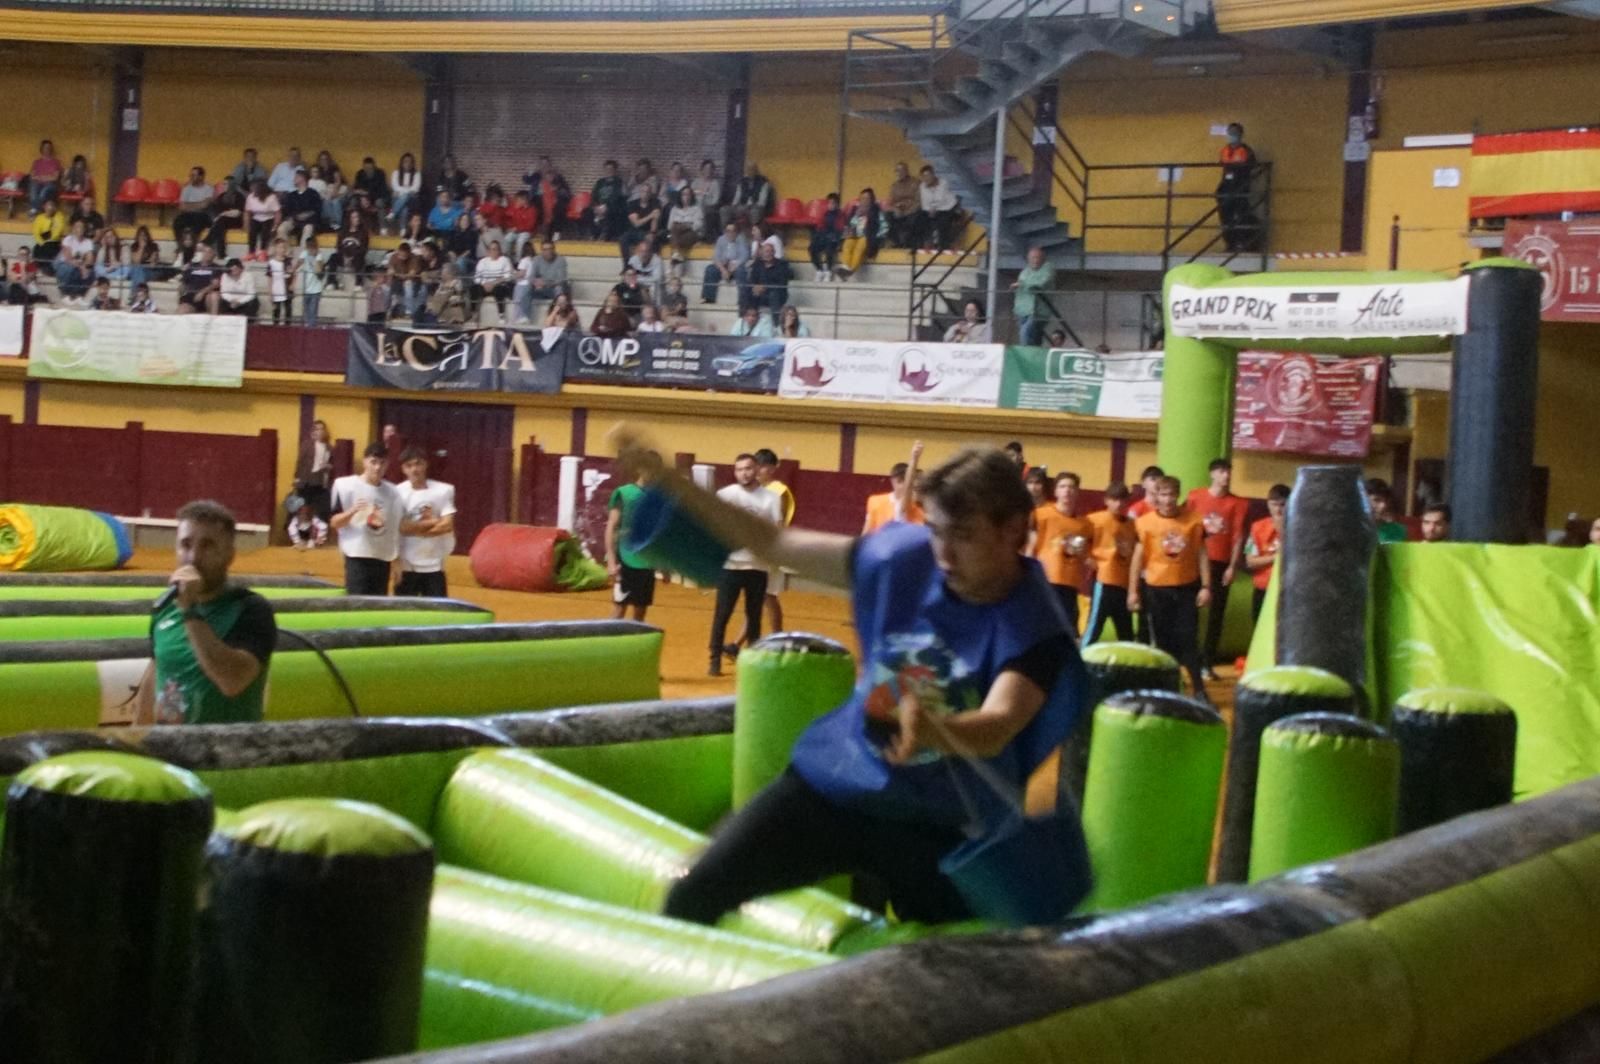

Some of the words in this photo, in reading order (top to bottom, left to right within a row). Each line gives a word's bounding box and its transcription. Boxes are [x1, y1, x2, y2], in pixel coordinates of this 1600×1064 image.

[1569, 266, 1591, 294] 15
[1171, 295, 1230, 320] GRAND
[1232, 295, 1278, 322] PRIX
[1351, 287, 1404, 325] Arte
[601, 338, 641, 366] MP
